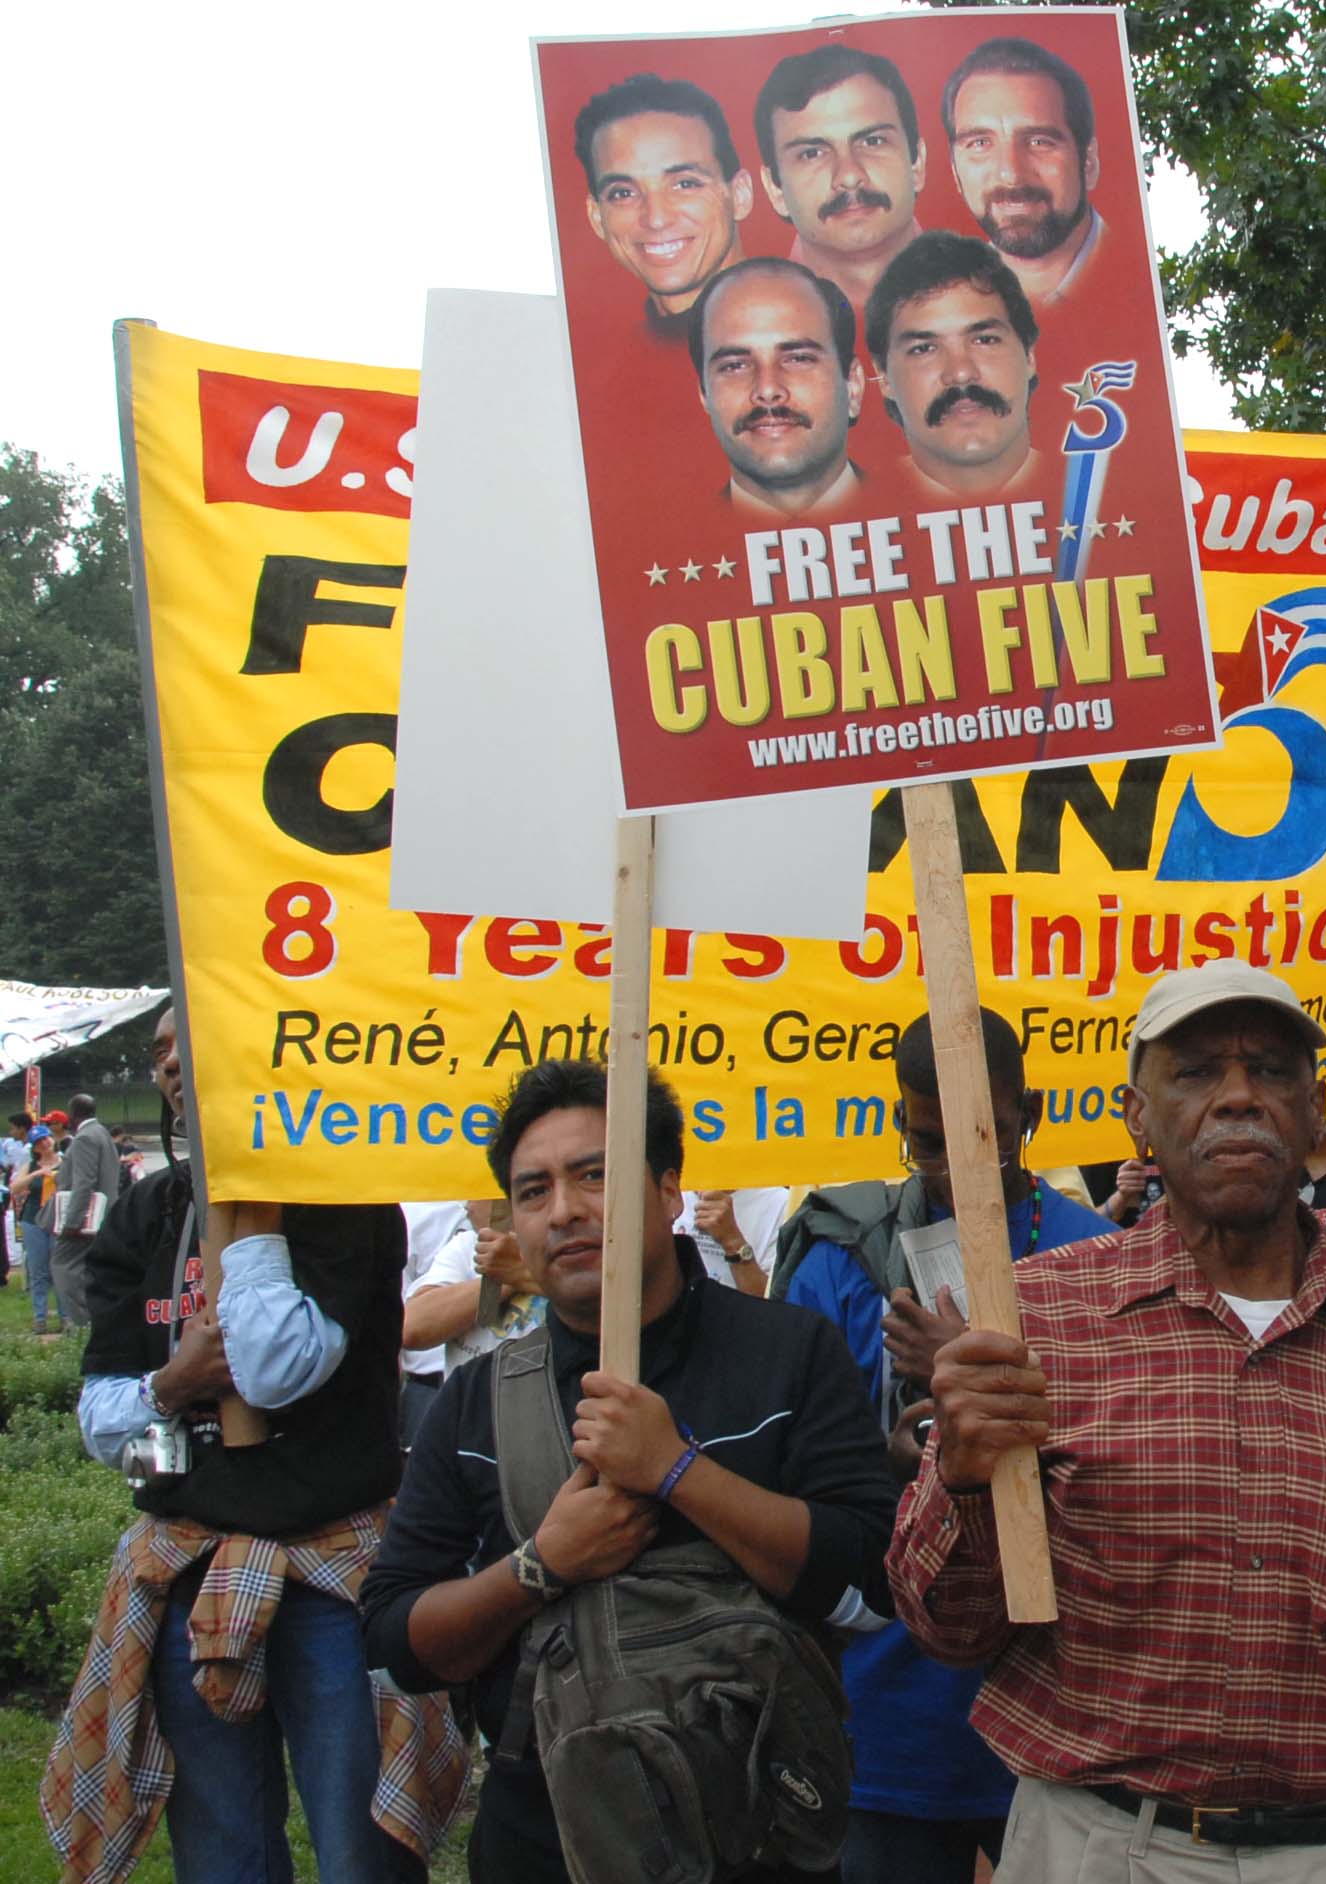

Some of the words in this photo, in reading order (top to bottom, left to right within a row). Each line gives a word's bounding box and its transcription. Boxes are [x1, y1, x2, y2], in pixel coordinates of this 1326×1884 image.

[744, 516, 910, 607] FREE
[916, 500, 1054, 585] THE
[645, 595, 957, 734] CUBAN
[976, 574, 1167, 695] FIVE
[747, 698, 1114, 768] www.freethefive.org
[264, 881, 337, 979] 8
[272, 1007, 460, 1076] René,
[482, 1009, 737, 1072] Antnio,
[755, 1087, 807, 1142] la
